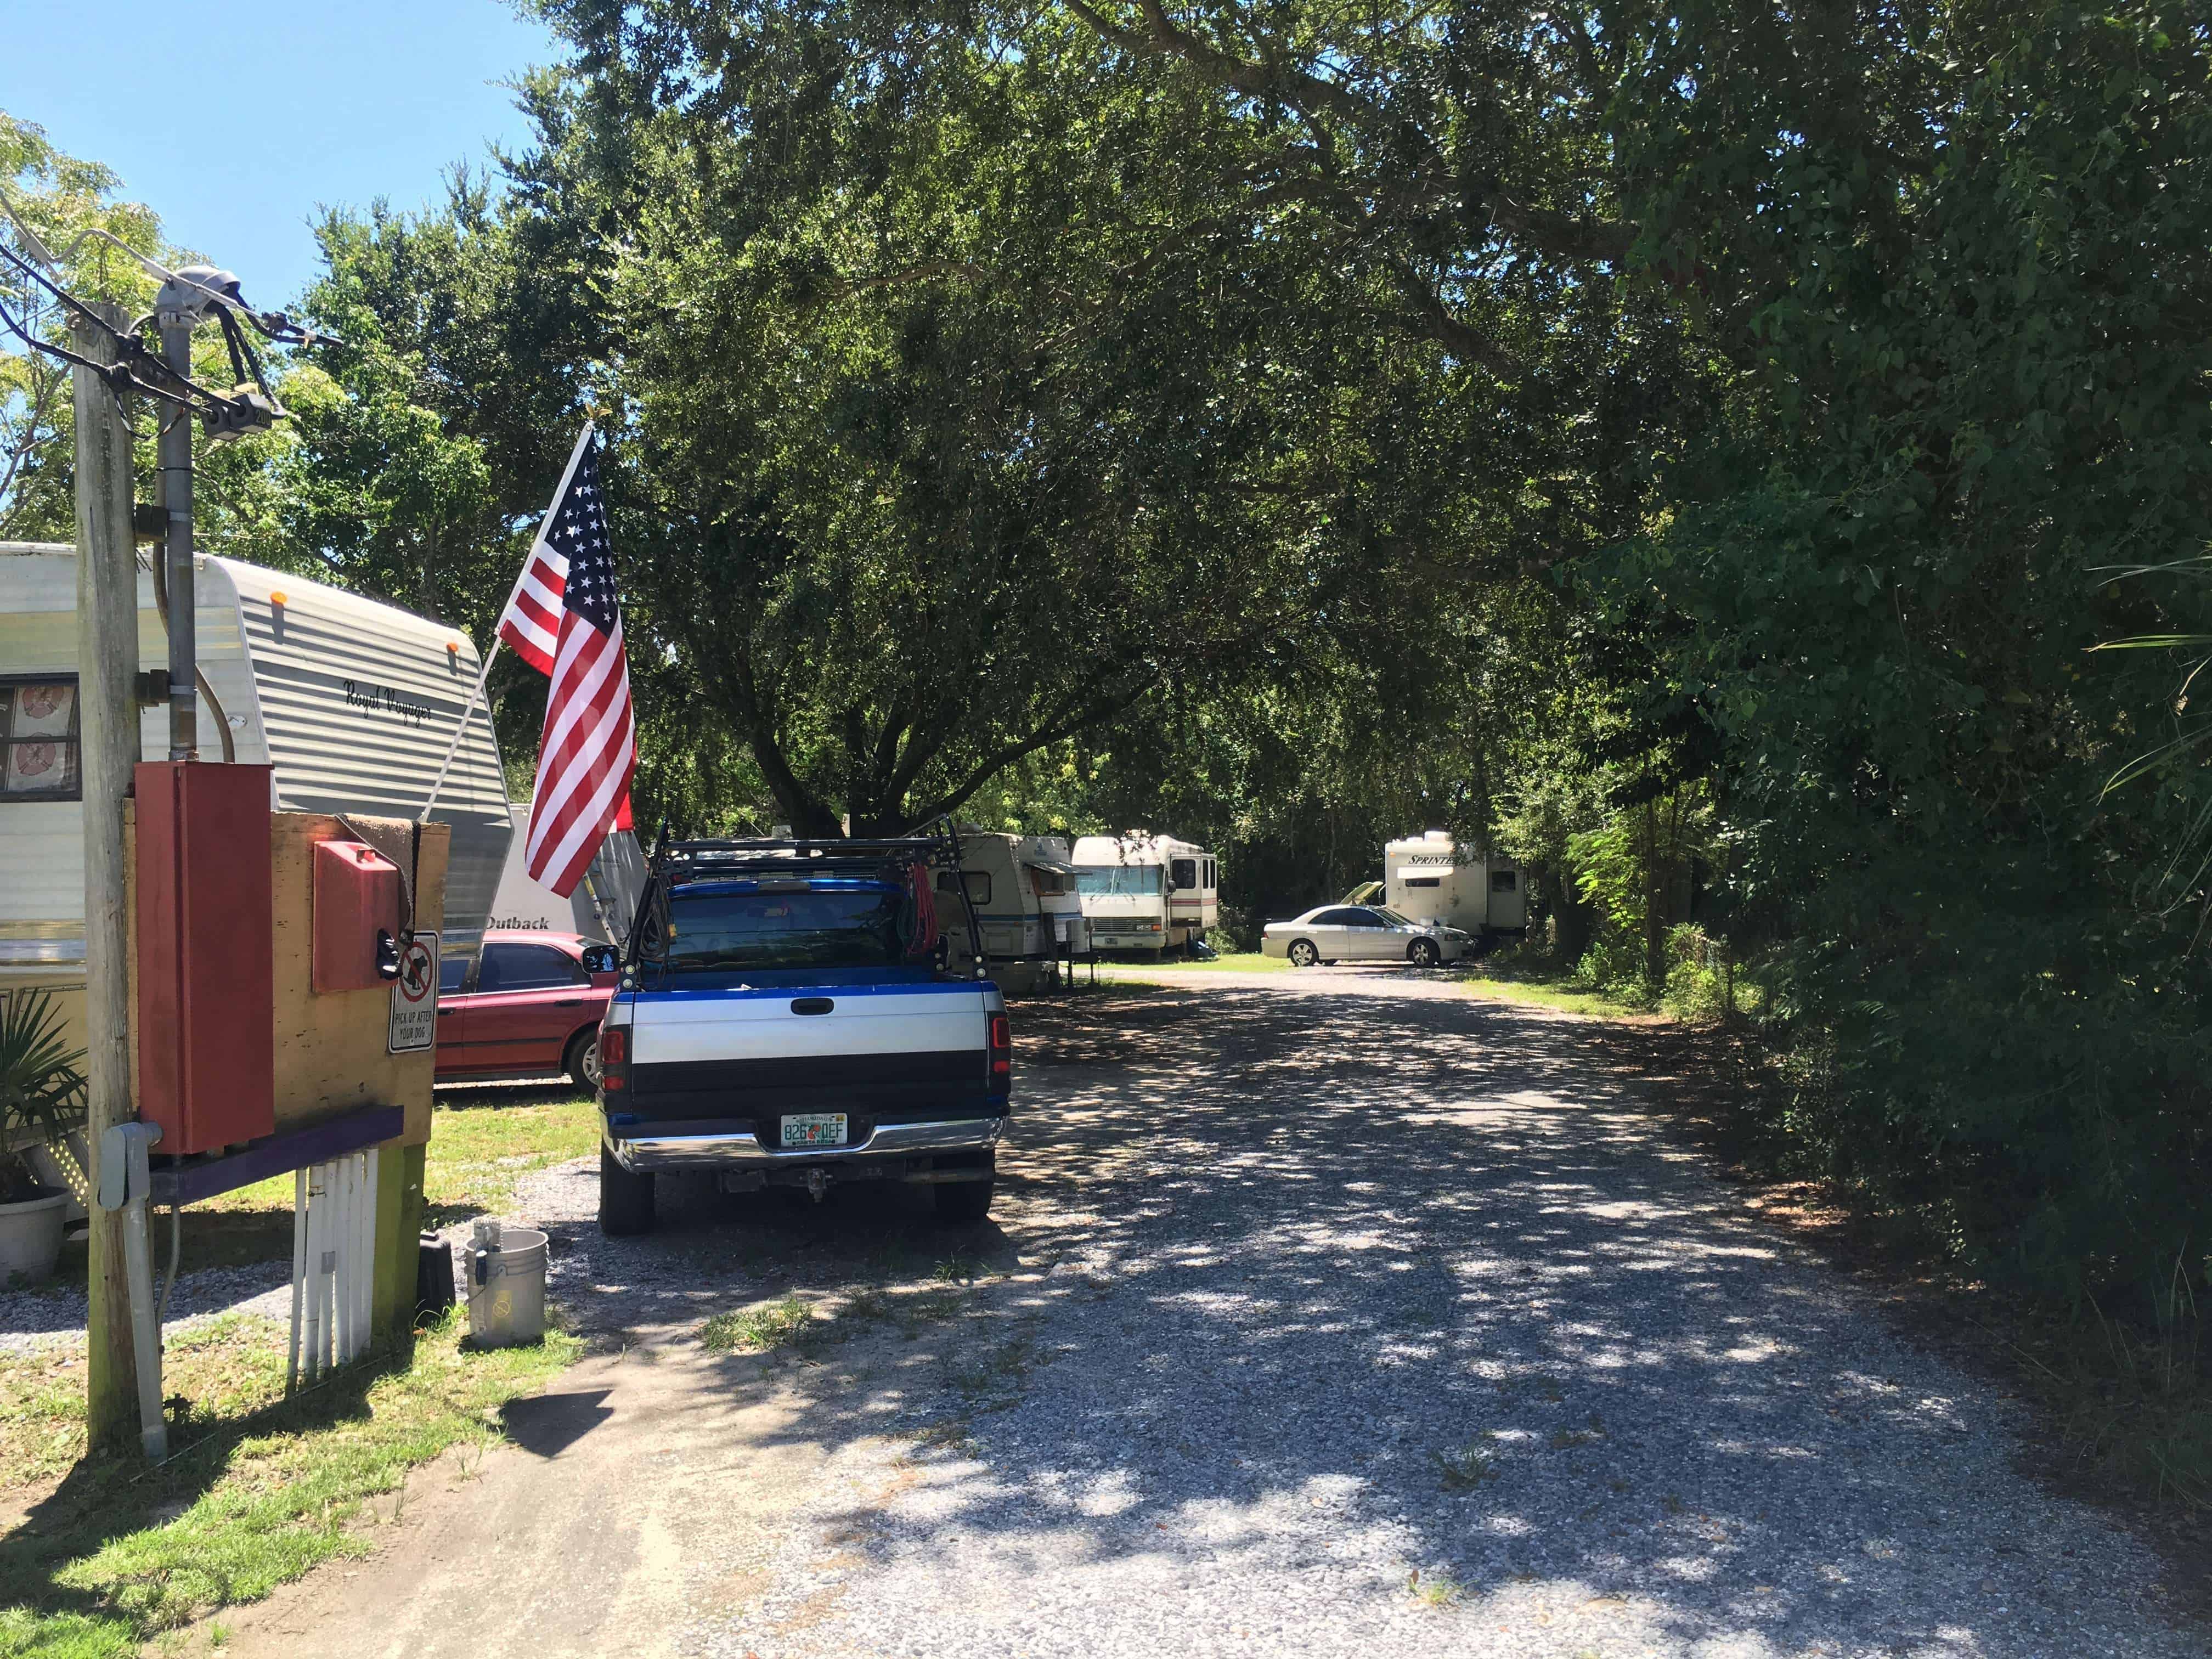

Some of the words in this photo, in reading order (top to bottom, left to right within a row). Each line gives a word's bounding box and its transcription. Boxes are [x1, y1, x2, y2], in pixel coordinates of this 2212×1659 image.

[343, 680, 381, 719] Royal
[385, 688, 432, 728] Voyager
[1408, 855, 1454, 865] SPRINTE
[395, 1013, 407, 1025] PICK
[409, 1012, 416, 1023] UP
[417, 1011, 431, 1022] AFTER
[399, 1028, 413, 1040] YOUR
[415, 1026, 425, 1038] DOG
[785, 1125, 806, 1140] 826
